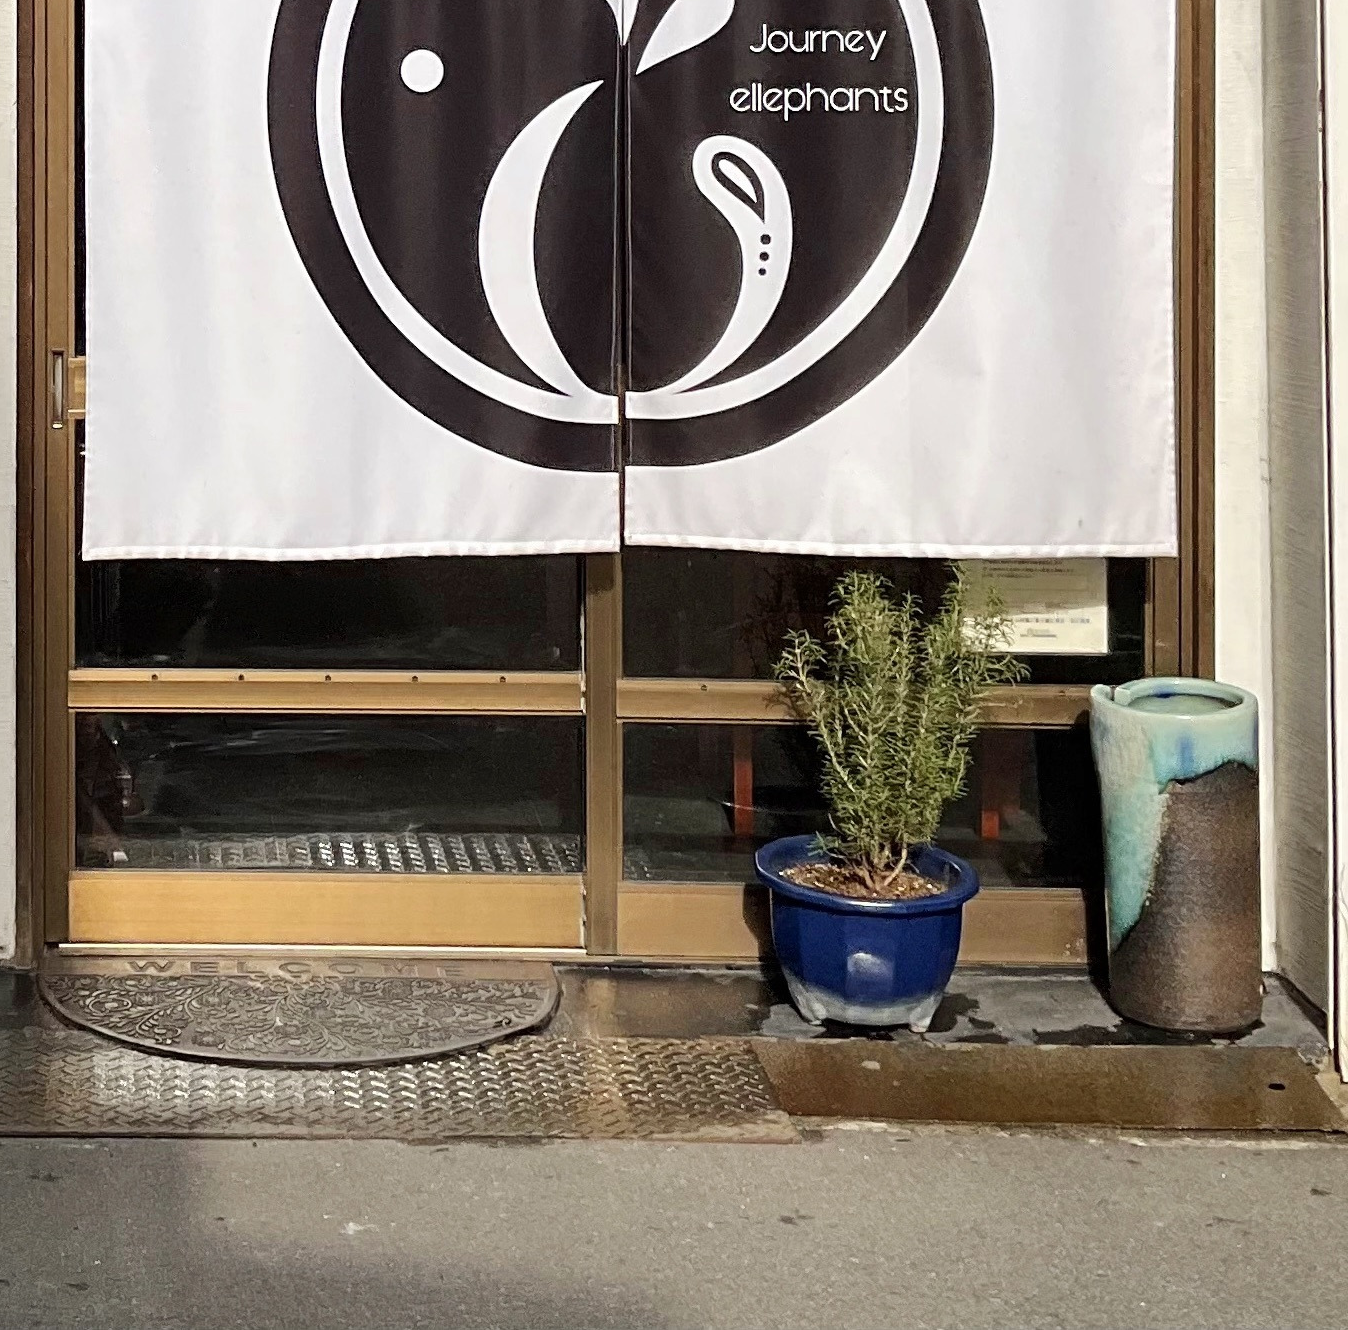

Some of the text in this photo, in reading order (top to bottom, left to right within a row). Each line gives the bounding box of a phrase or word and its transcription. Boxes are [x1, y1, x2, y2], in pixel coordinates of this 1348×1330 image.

[749, 23, 887, 61] Journey
[729, 82, 909, 122] ellephants
[127, 960, 464, 978] WELCOME
